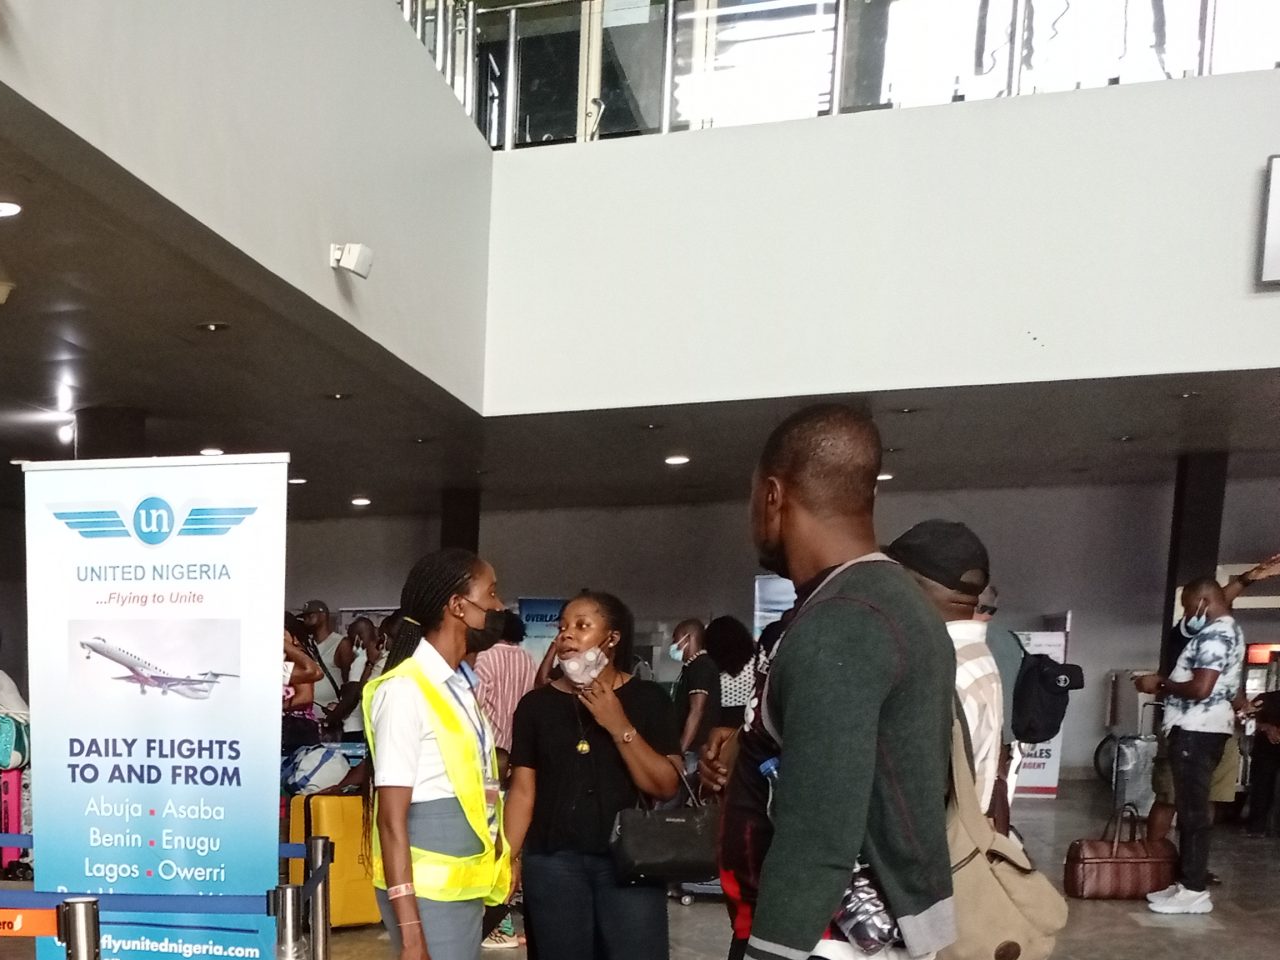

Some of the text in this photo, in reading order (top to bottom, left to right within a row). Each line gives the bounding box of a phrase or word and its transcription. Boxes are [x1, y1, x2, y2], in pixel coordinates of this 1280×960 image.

[76, 563, 231, 582] UNITED NIGERIA
[96, 591, 204, 607] ...Flying to Unite
[69, 738, 241, 761] DAILY FLIGHTS
[67, 763, 242, 787] TO AND FROM
[84, 795, 224, 823] Abuja Asaba
[89, 826, 221, 856] Benin Enugu
[84, 857, 225, 883] Lagos Owerri
[55, 934, 260, 959] flyunitednigeria.com
